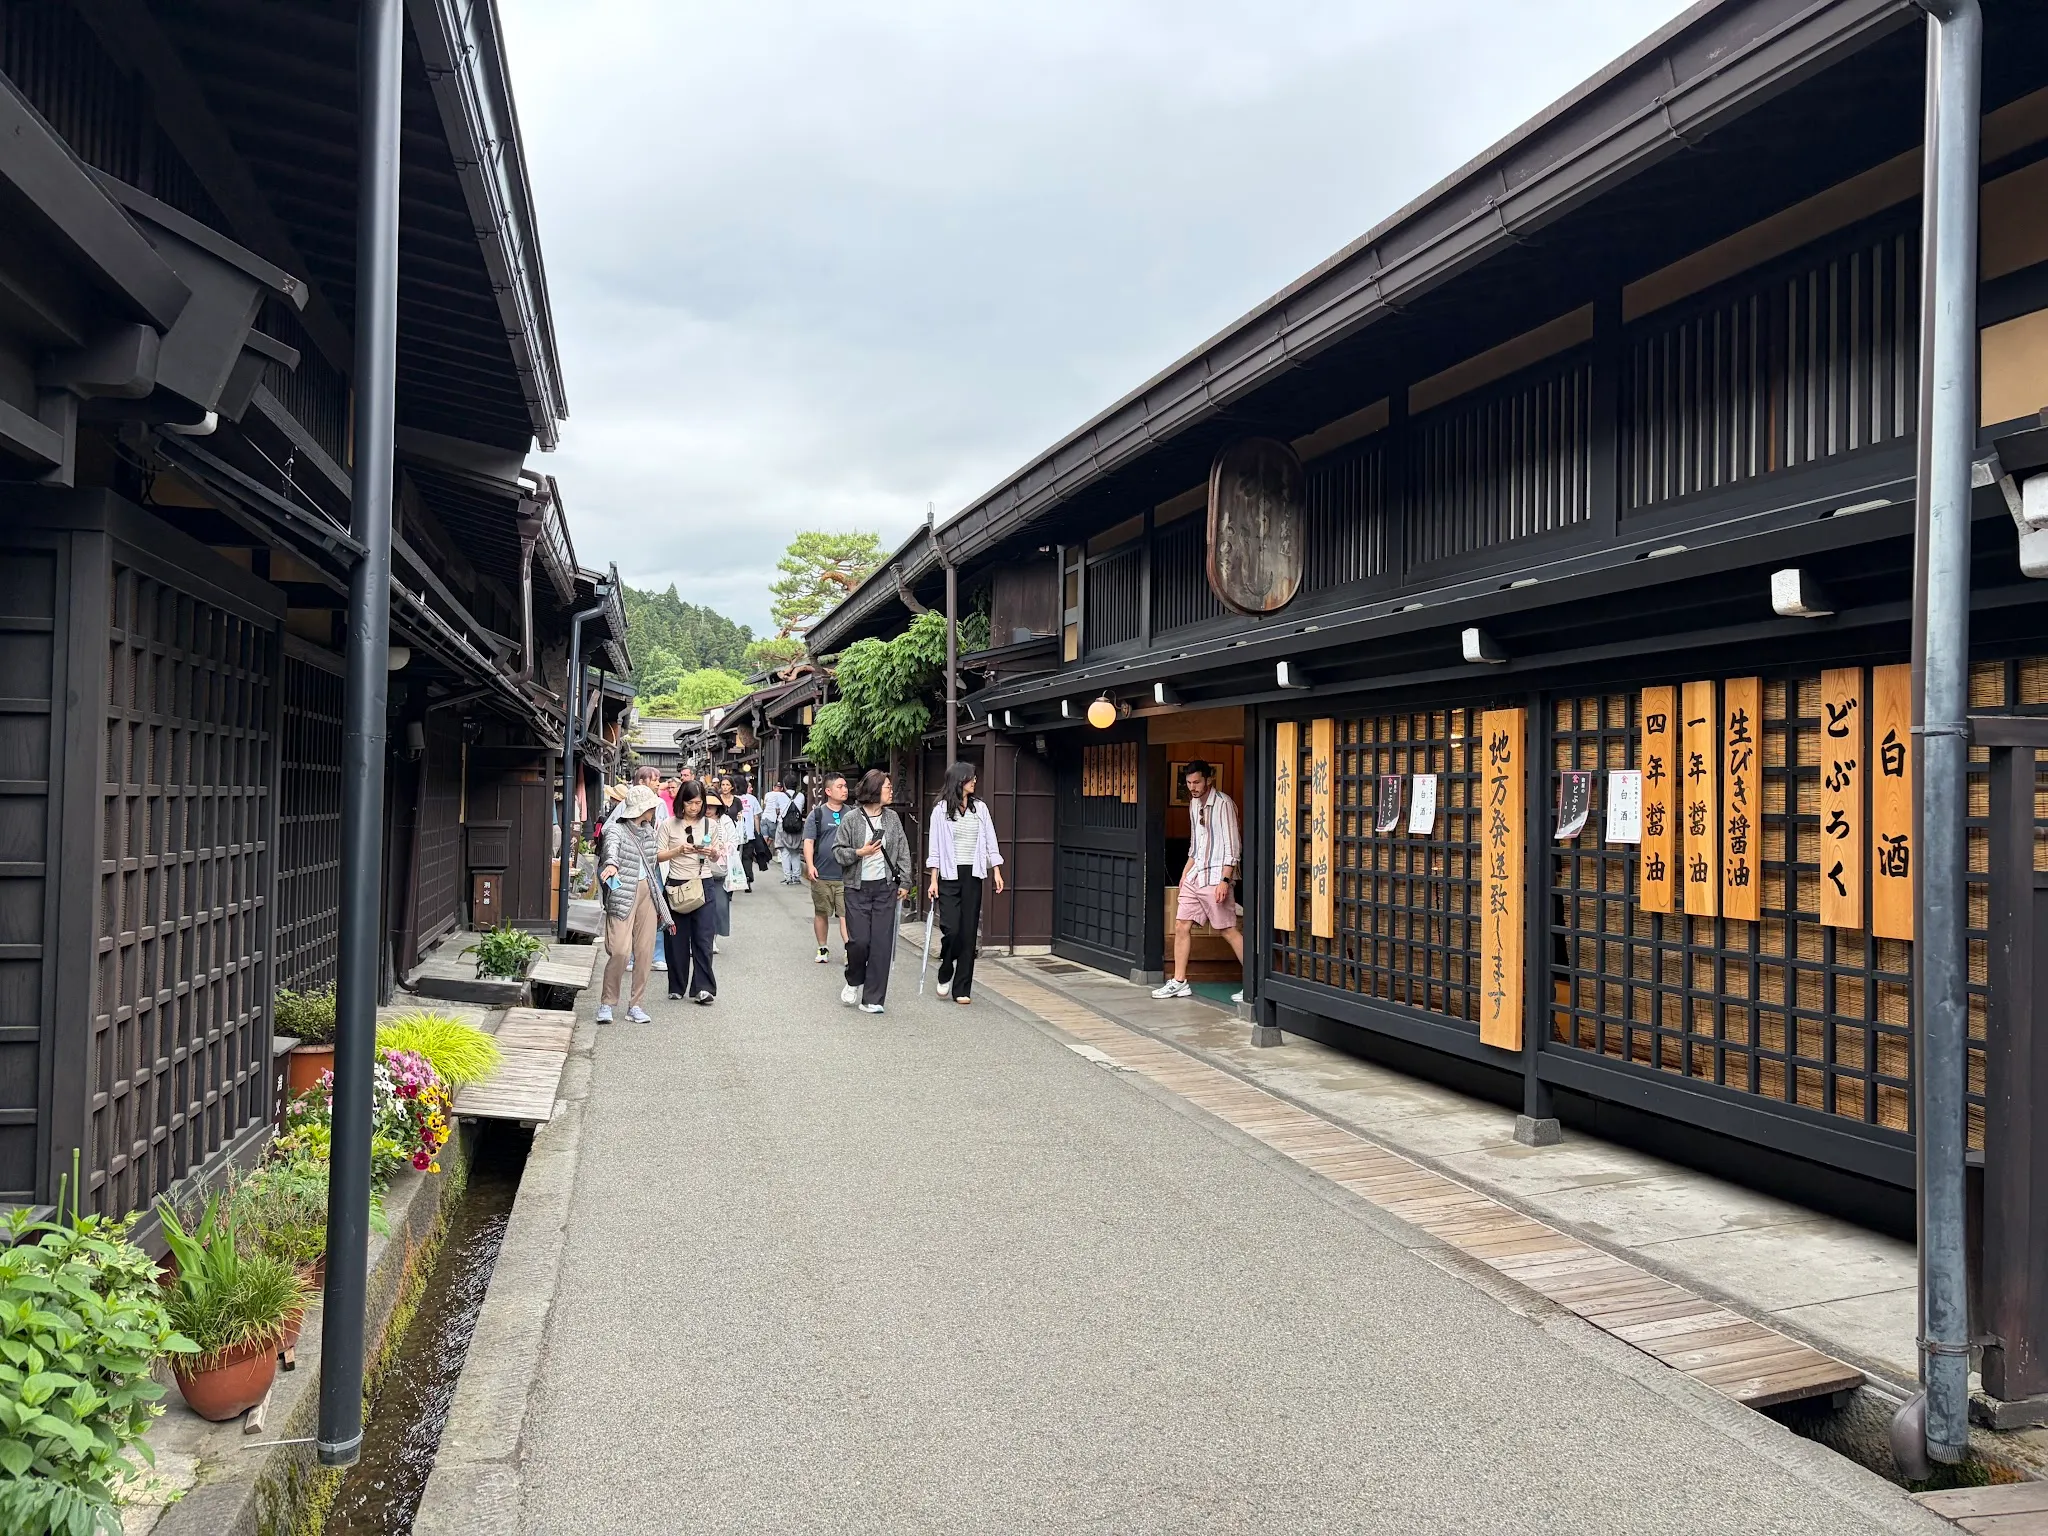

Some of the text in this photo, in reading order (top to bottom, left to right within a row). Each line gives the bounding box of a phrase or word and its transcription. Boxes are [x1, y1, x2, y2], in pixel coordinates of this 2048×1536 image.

[1275, 760, 1292, 891] 赤味噌
[1312, 755, 1330, 897] 糀味噌
[1488, 729, 1511, 1020] 地方発送致します
[1645, 713, 1667, 882] 四年醤油
[1687, 717, 1708, 883] 一年醤油
[1726, 707, 1754, 887] 生びき醤油
[1825, 697, 1858, 897] どぶろく
[1877, 728, 1910, 878] 白酒
